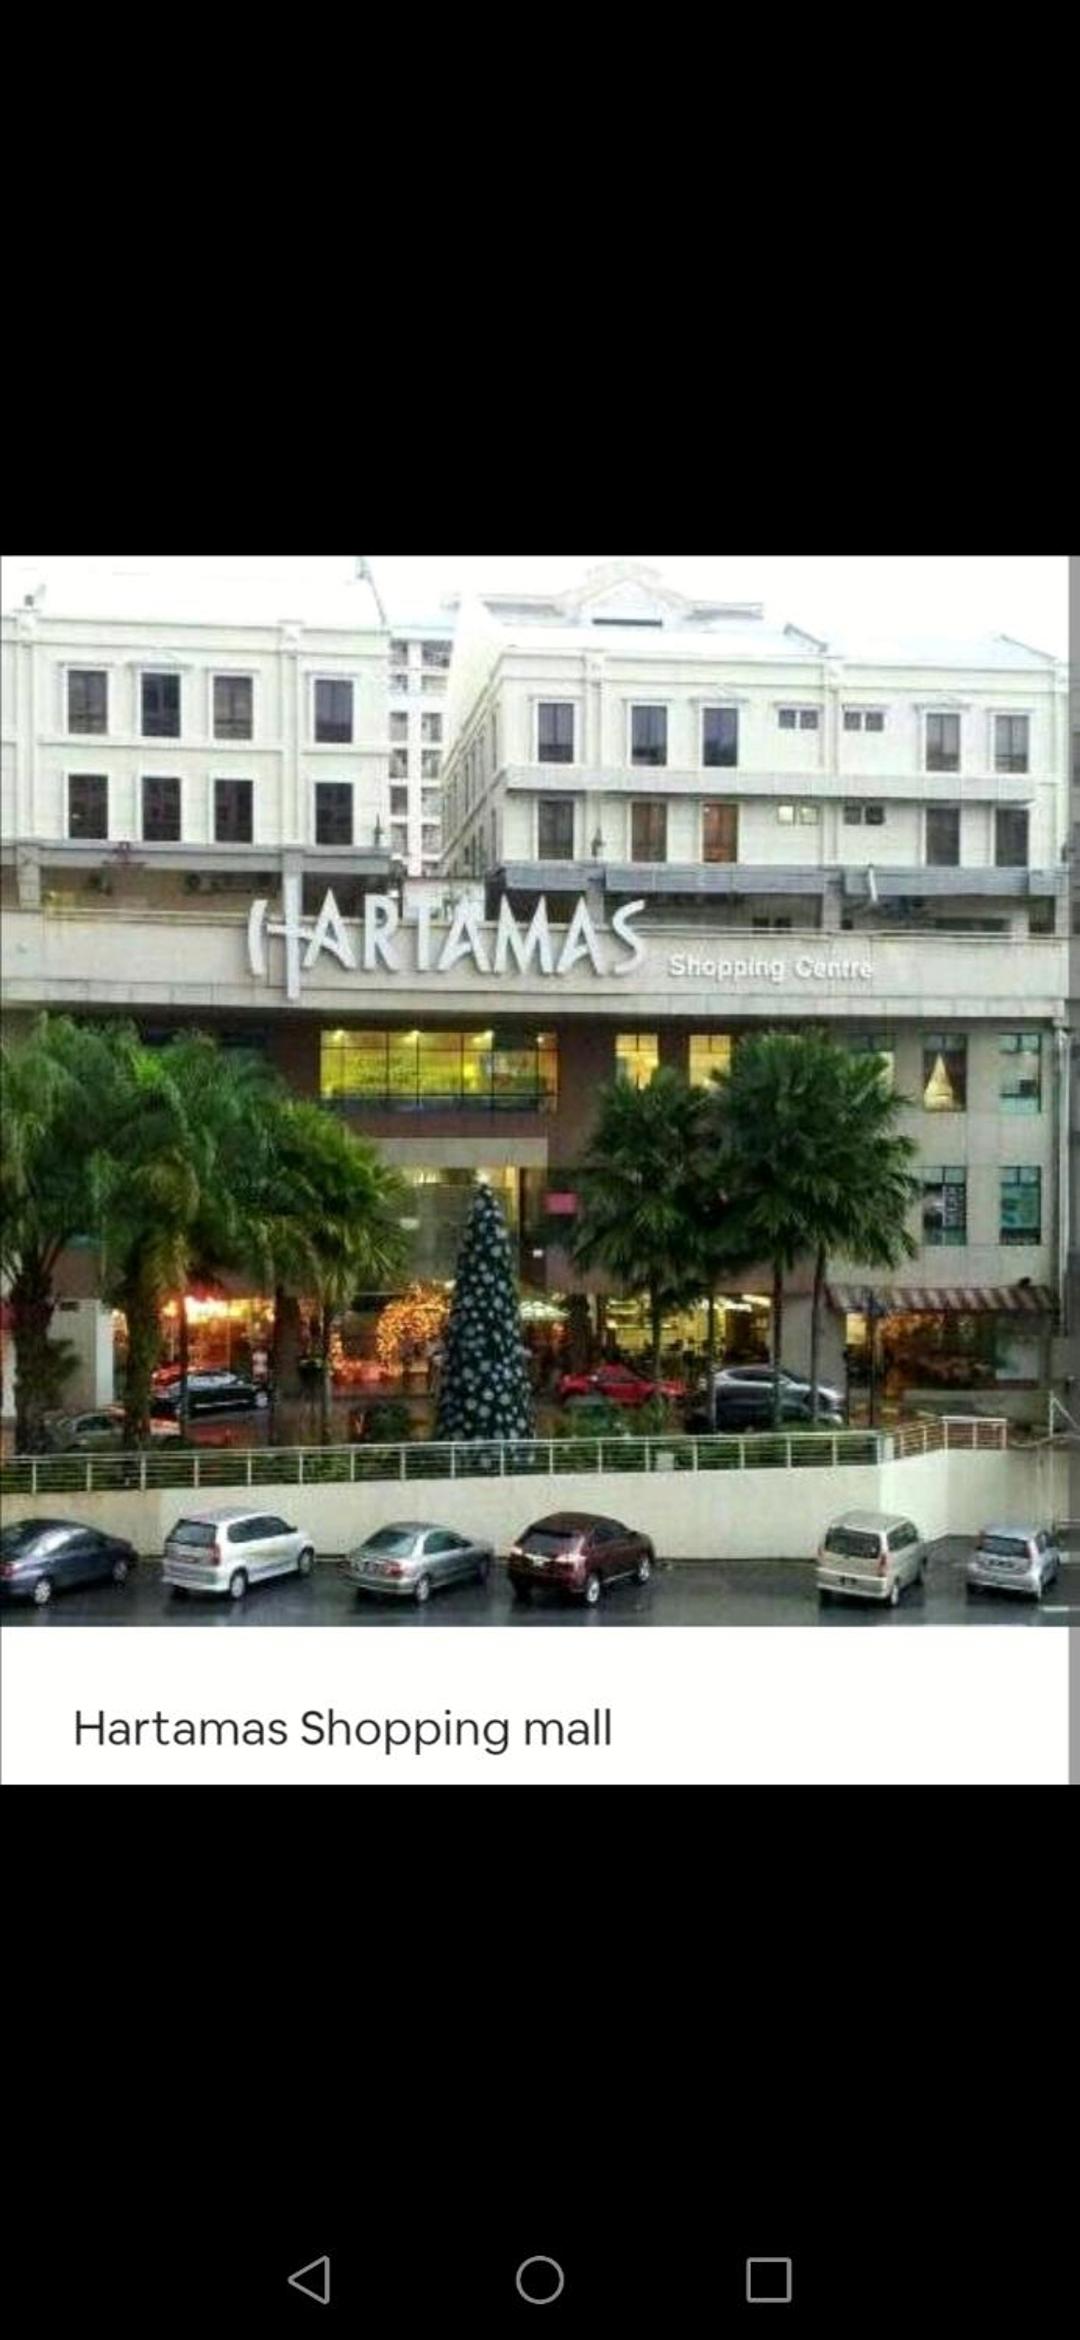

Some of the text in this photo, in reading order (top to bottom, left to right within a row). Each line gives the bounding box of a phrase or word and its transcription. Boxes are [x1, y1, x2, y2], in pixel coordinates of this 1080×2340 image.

[248, 888, 646, 998] HARTAMAS
[669, 954, 874, 982] Shopping Centre
